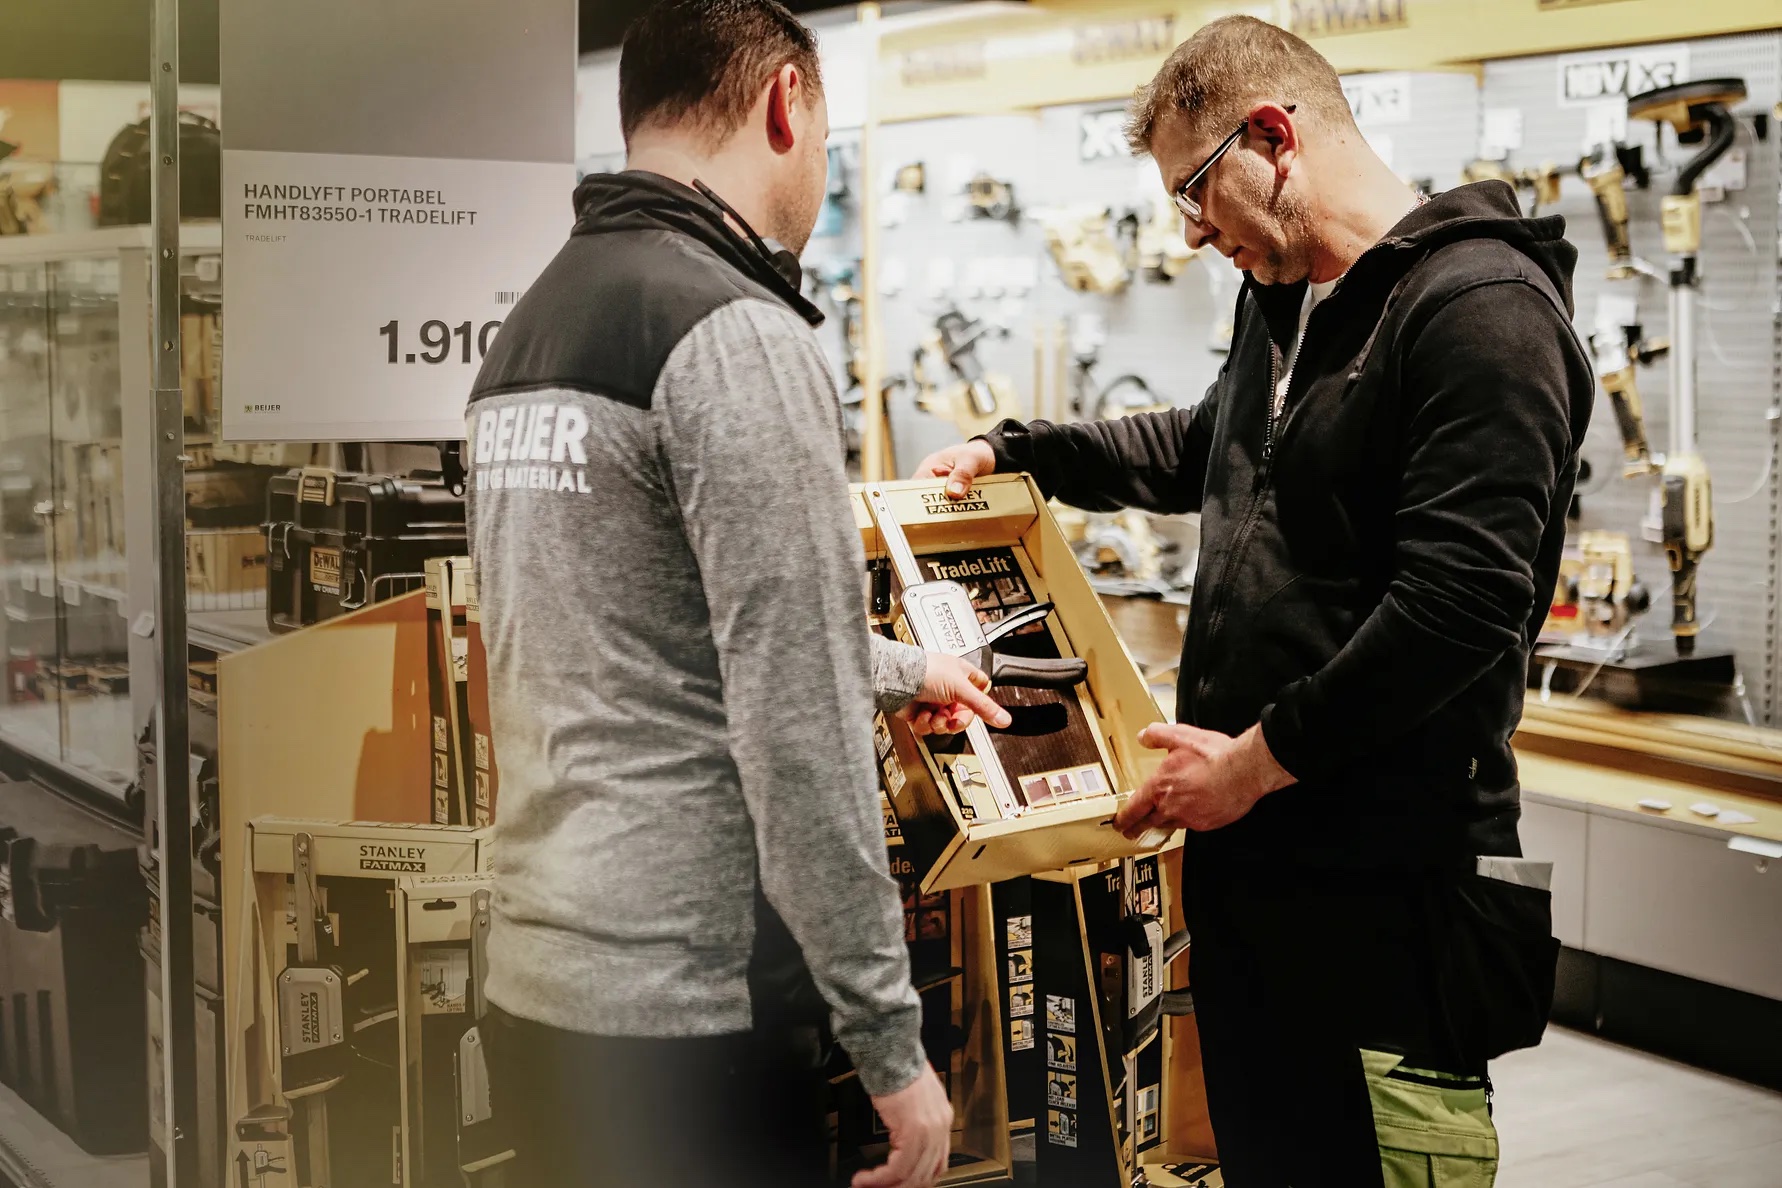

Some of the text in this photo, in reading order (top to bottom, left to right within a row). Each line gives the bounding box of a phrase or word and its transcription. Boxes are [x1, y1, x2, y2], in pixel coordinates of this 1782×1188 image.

[244, 183, 446, 205] HANDLYFT PORTABEL
[244, 204, 477, 225] FMHT83550-1 TRADELIFT
[245, 234, 286, 242] TRADELIFT
[921, 489, 983, 503] STAEY
[927, 502, 987, 515] FATMAX
[314, 552, 340, 569] DEWAL
[927, 555, 1010, 580] TradeLift
[360, 845, 426, 859] STANLEY
[362, 860, 424, 872] FATMAX
[1105, 863, 1153, 892] TraLift
[301, 992, 311, 1043] STANLEY
